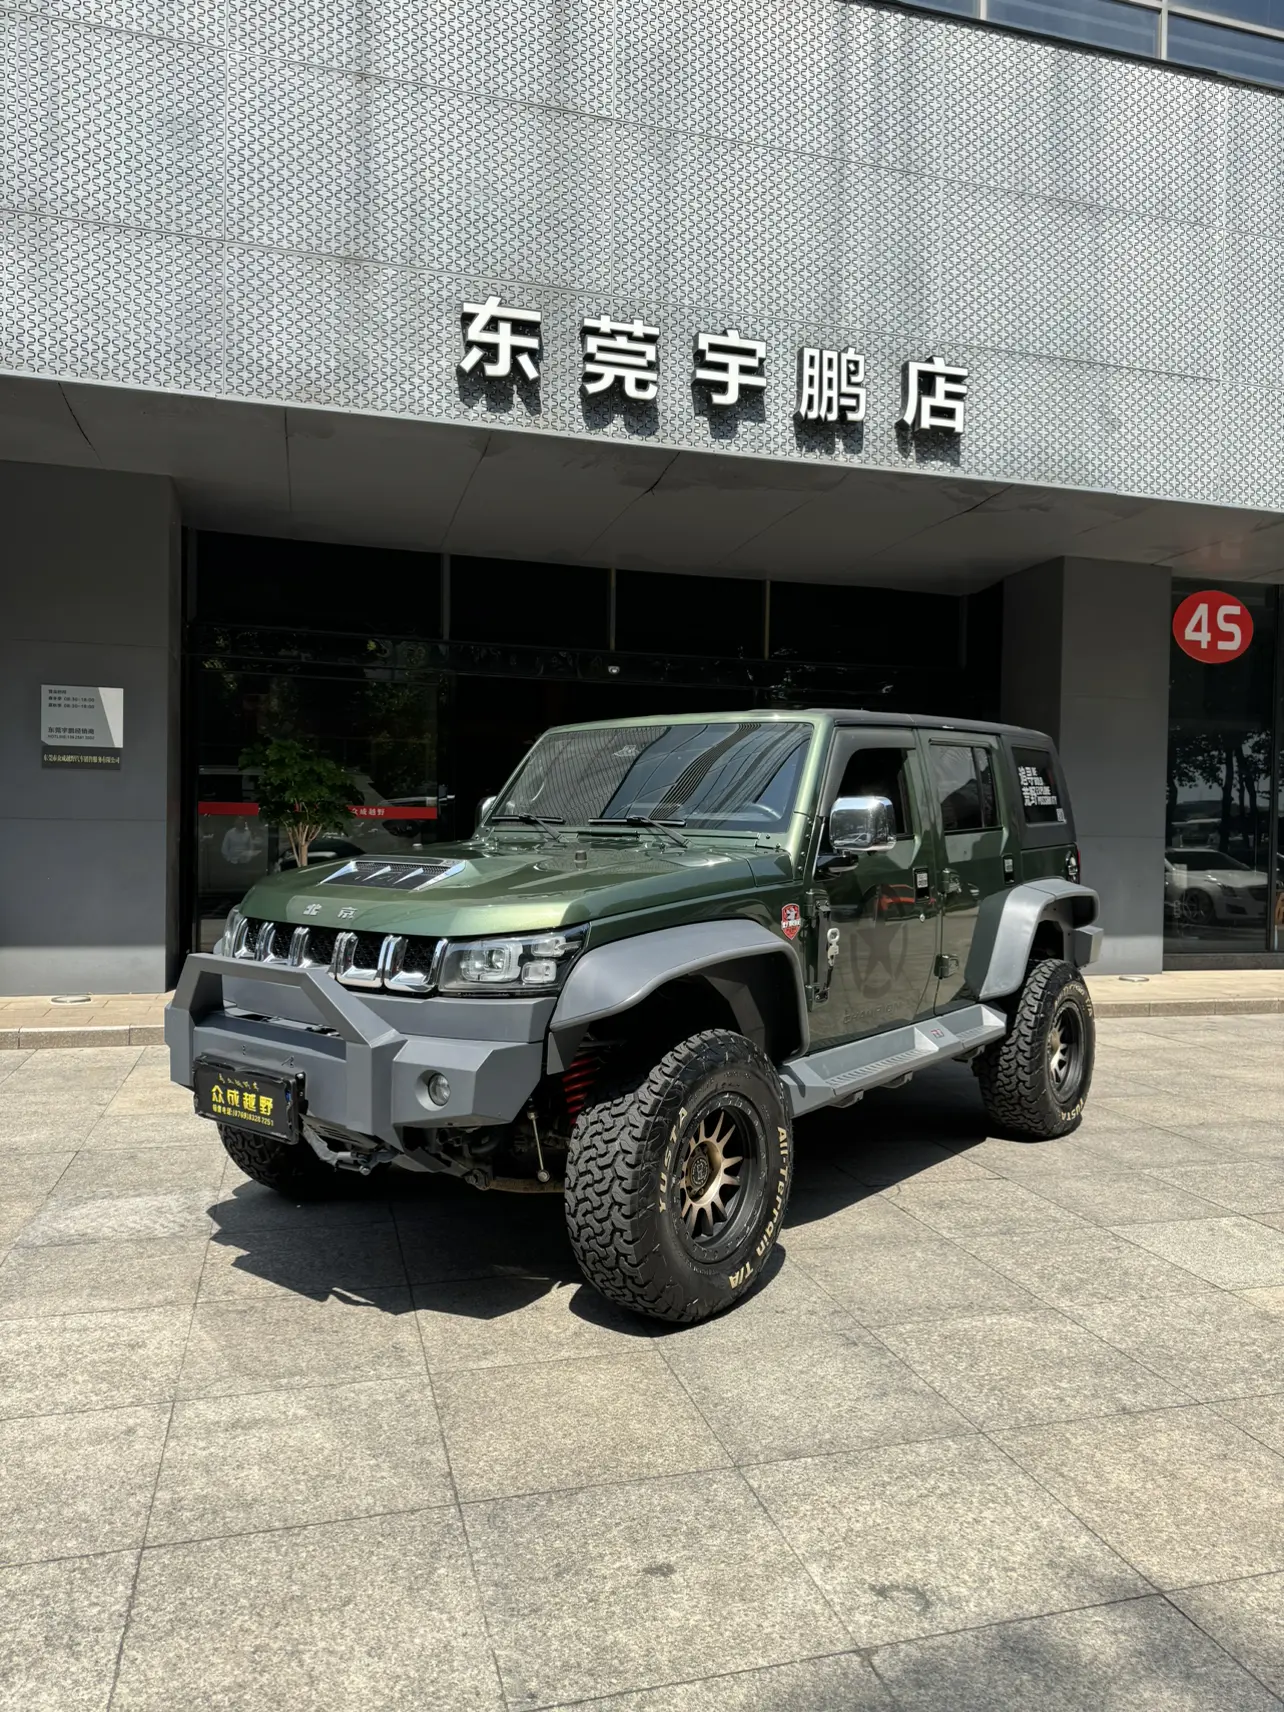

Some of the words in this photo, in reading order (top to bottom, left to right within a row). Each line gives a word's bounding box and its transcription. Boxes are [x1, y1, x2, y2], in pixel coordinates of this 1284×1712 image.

[457, 296, 968, 433] 东莞宇鹏店
[1184, 603, 1241, 650] 4S
[303, 903, 358, 920] 北京
[211, 1085, 274, 1116] 众成越野
[659, 1107, 688, 1213] YUSTA
